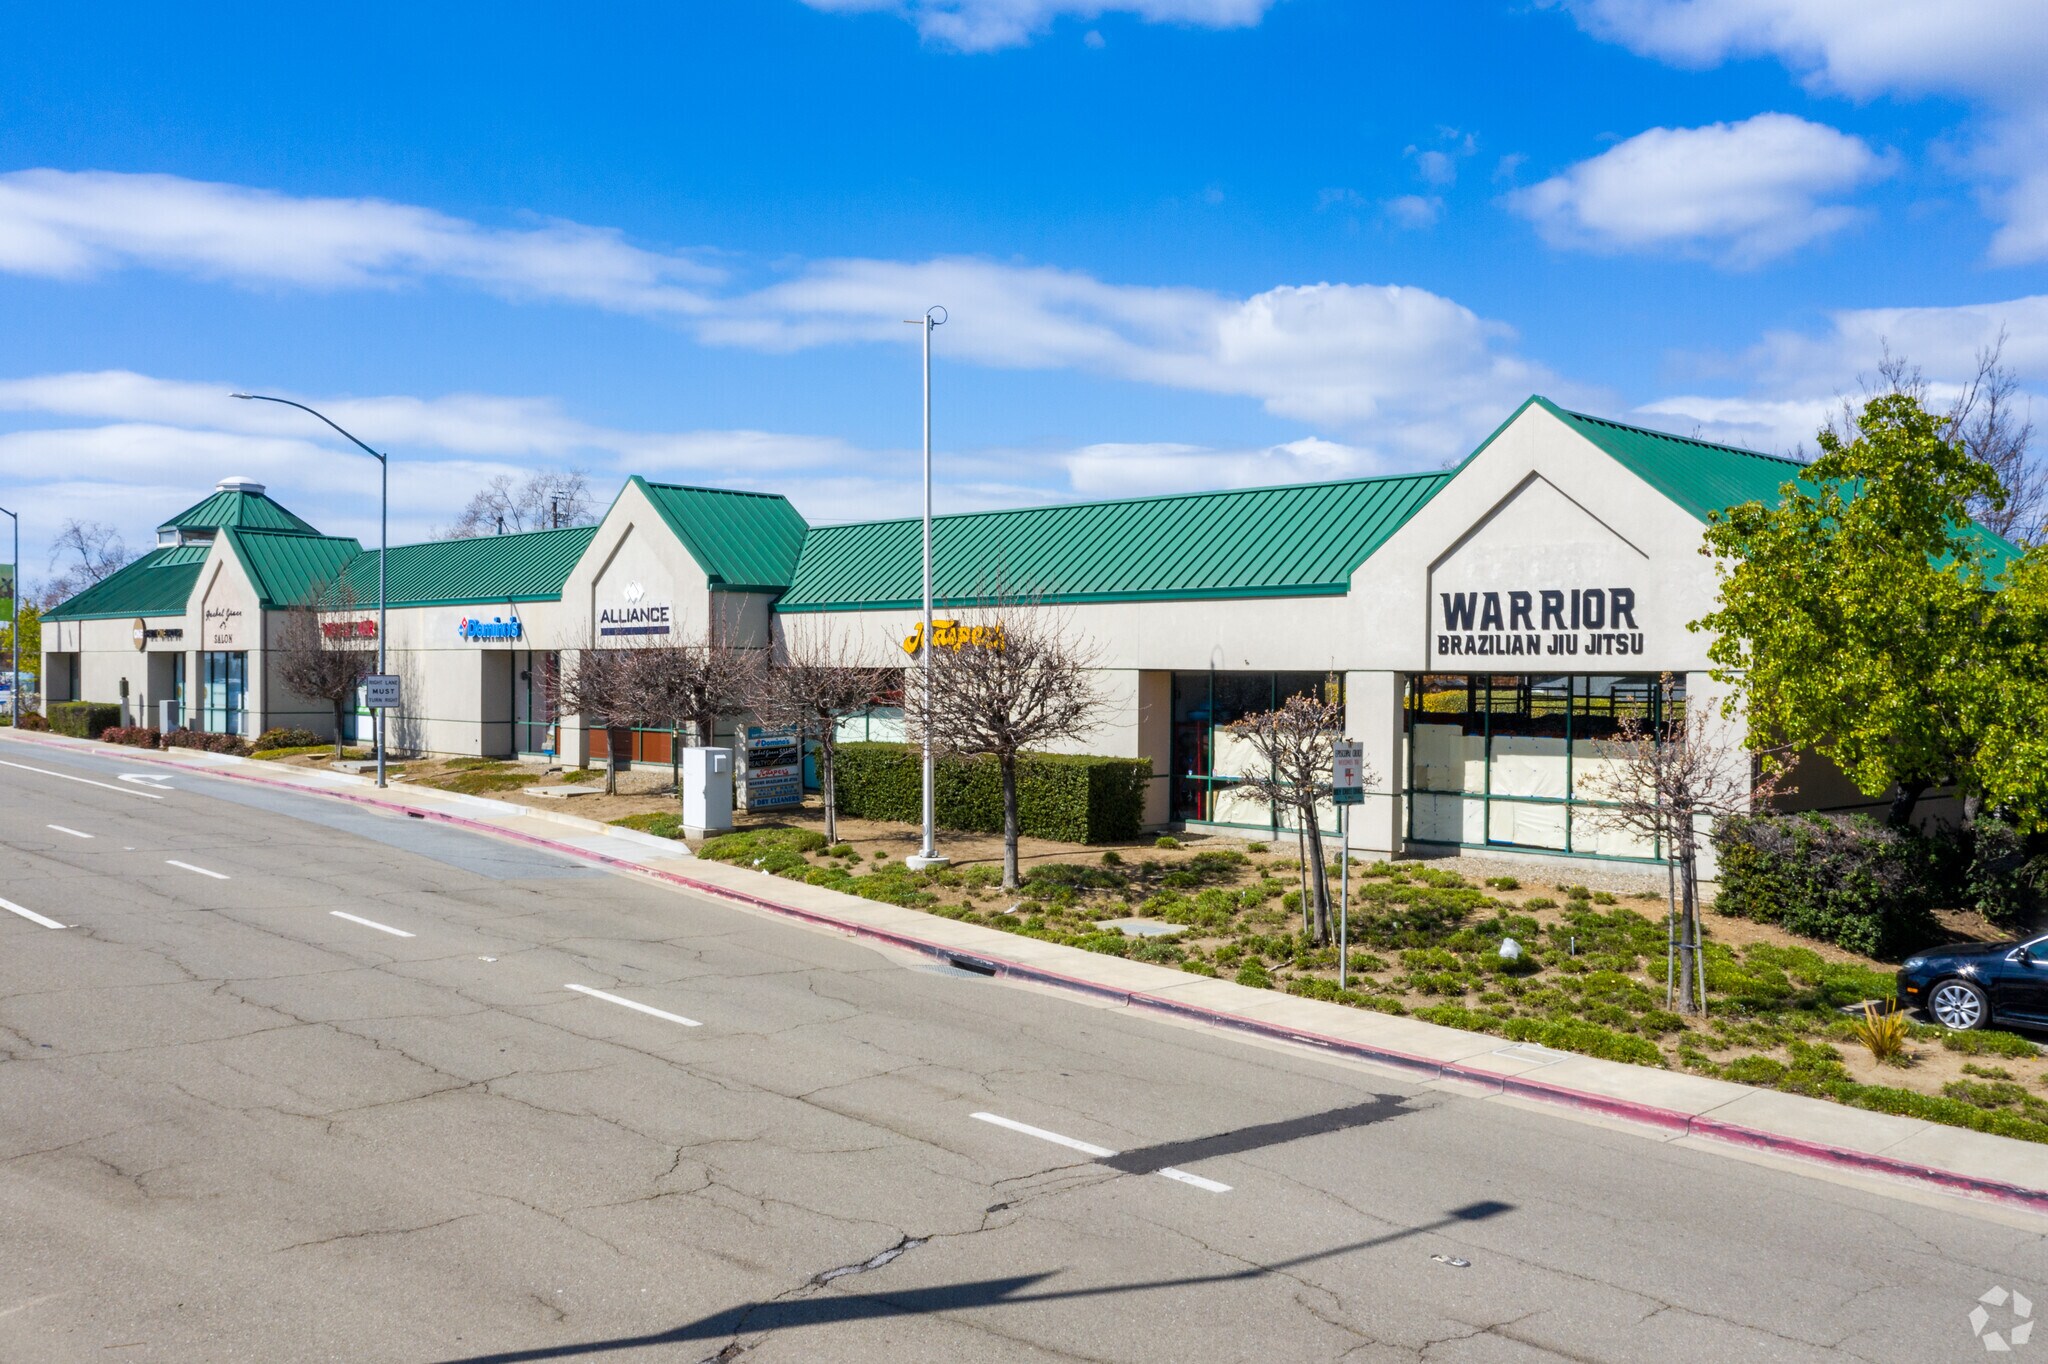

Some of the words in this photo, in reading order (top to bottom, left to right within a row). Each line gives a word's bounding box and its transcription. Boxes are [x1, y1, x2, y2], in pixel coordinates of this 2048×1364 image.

[600, 606, 669, 623] ALLIANCE
[1440, 587, 1638, 631] WARRIOR
[467, 615, 519, 638] Domino's
[213, 634, 233, 644] SALON
[1437, 634, 1541, 655] BRAZILIAN
[1547, 633, 1578, 655] JIU
[1584, 633, 1644, 655] JITSU
[761, 737, 790, 747] Domino's
[757, 798, 769, 806] DRY
[770, 795, 800, 804] CLEANERS
